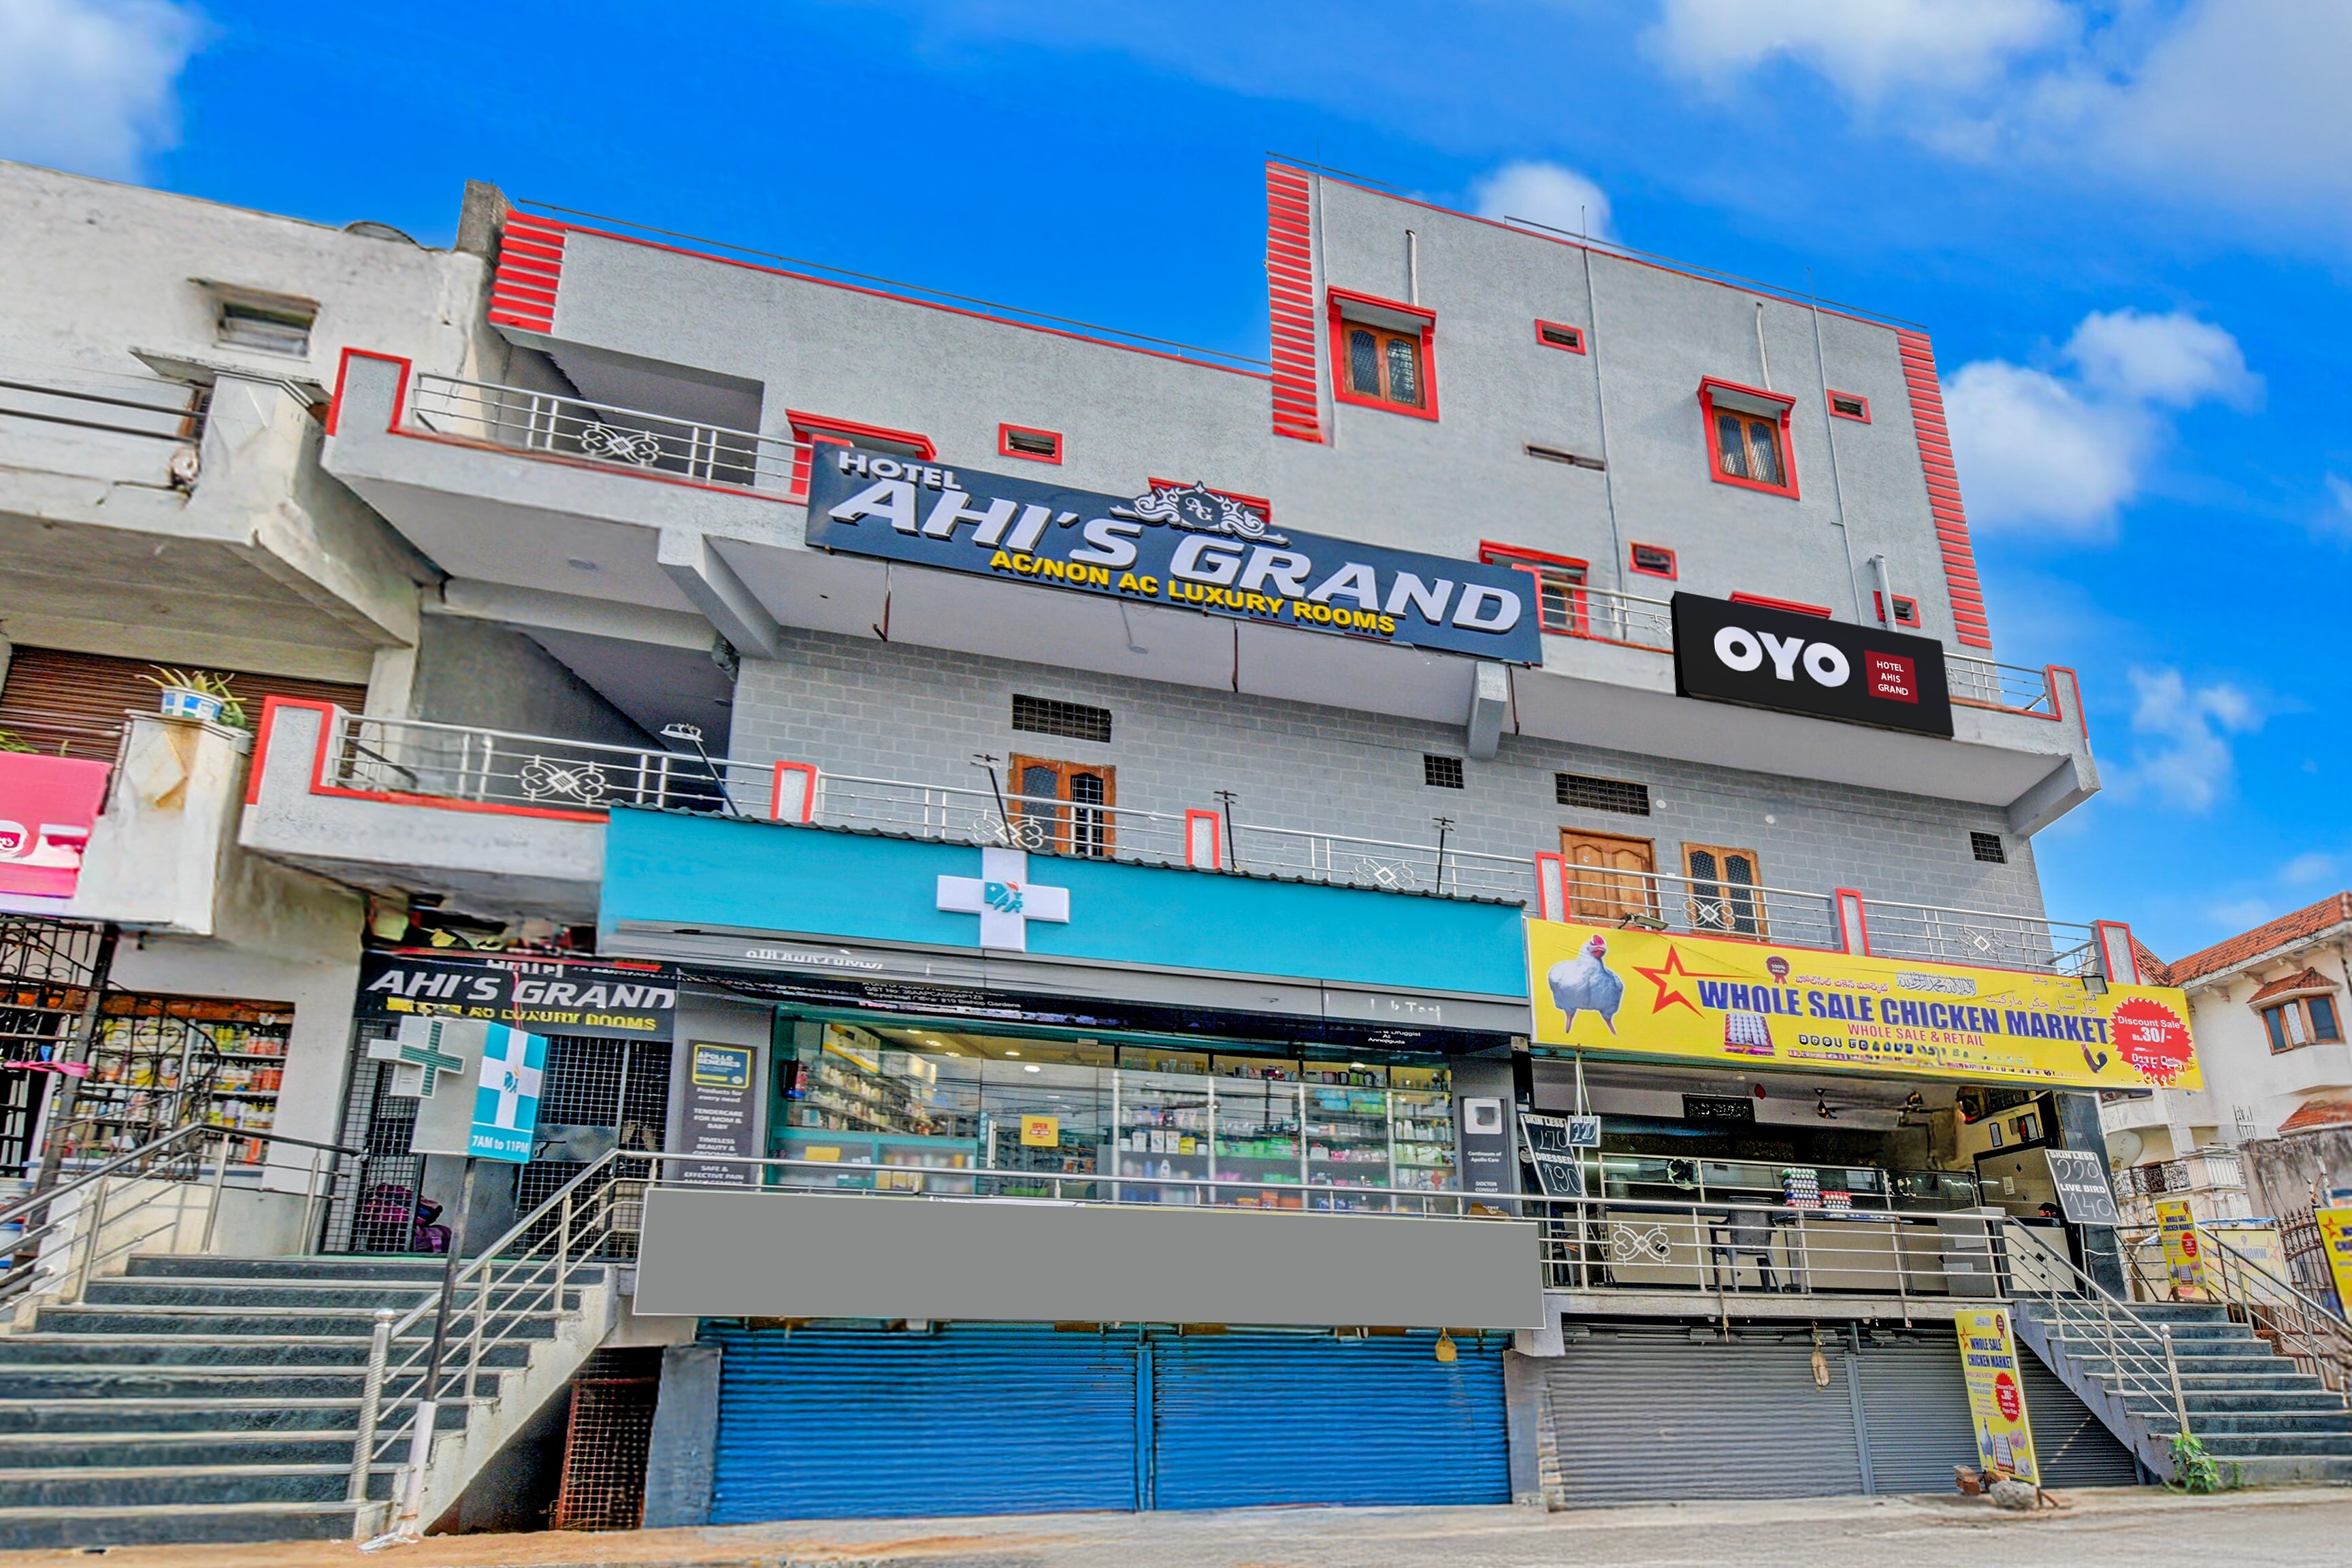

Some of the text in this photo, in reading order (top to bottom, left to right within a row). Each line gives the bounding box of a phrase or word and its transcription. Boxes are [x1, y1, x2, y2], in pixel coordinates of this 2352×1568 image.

[838, 451, 962, 491] HOTEL
[828, 479, 1522, 634] AHI'S GRAND
[990, 551, 1396, 635] AC/NON AC LUXURY ROOMS
[1714, 626, 1850, 687] OYO
[1876, 660, 1904, 672] HOTEL
[1881, 672, 1901, 683] AHIS
[1878, 683, 1909, 696] GRAND
[366, 970, 676, 1010] AHI'S GRAND
[1697, 979, 2108, 1044] WHOLE SALE CHICKEN MARKET
[2117, 1016, 2180, 1029] Discount Sale
[1848, 1024, 1891, 1039] WHOLE
[1896, 1028, 1927, 1042] SALE
[1931, 1031, 1940, 1043] &
[1944, 1032, 1985, 1047] RETAIL
[698, 1051, 734, 1061] APOLLO
[1524, 1115, 1564, 1128] SKIN LESS
[1571, 1124, 1596, 1142] 220
[472, 1135, 529, 1153] 7AM to 11PM
[1535, 1152, 1573, 1164] DRESSED
[2059, 1183, 2106, 1193] LIVE BIRD
[2070, 1192, 2111, 1218] 140
[1970, 1338, 2002, 1351] WHOLE SALE
[1967, 1354, 2013, 1369] CHICKEN MARKET
